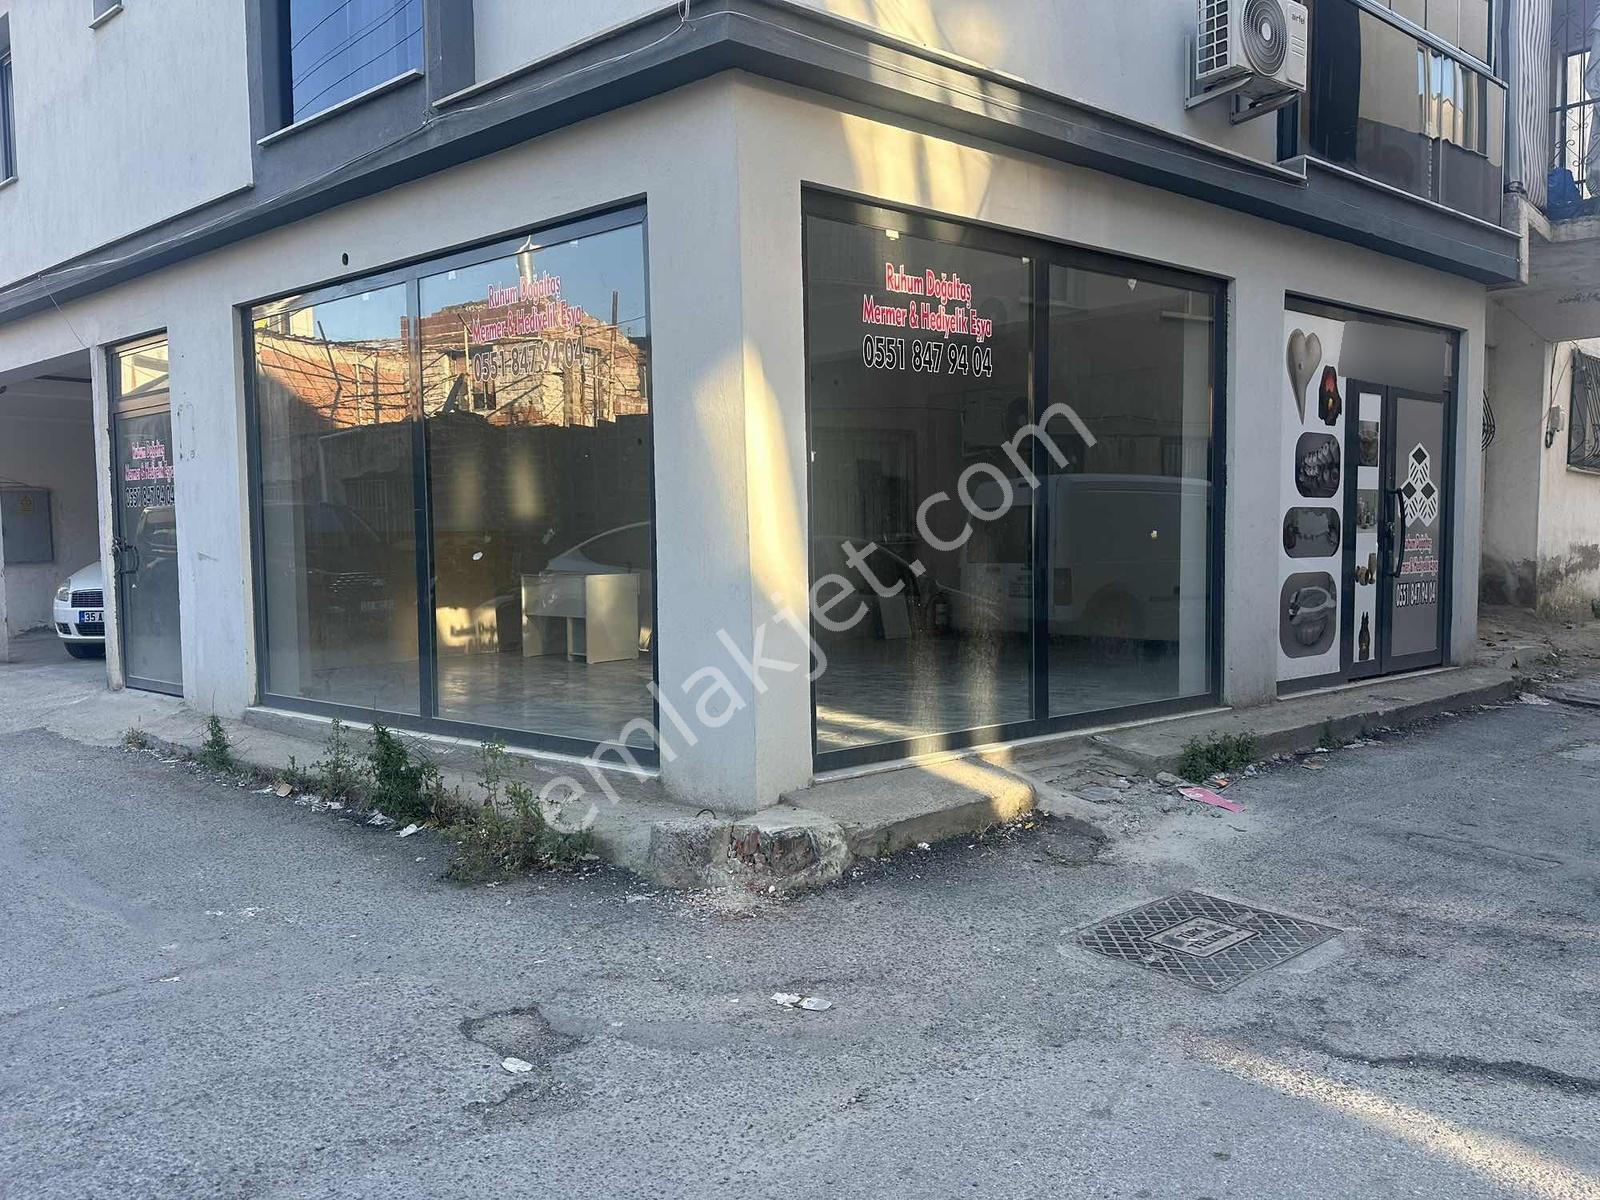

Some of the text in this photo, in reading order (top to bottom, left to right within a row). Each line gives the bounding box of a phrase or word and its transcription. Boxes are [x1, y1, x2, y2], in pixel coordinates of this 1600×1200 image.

[487, 282, 519, 309] Ruhum
[885, 262, 972, 309] Ruhum Doğaltaş
[472, 315, 507, 343] Mermer
[507, 310, 517, 337] &
[516, 302, 560, 337] Hediyelik
[862, 294, 993, 343] Mermer & Hediyelik Eşya
[473, 335, 584, 382] 0551 847 94 04
[862, 334, 993, 378] 0551 847 94 04
[85, 612, 96, 622] 35
